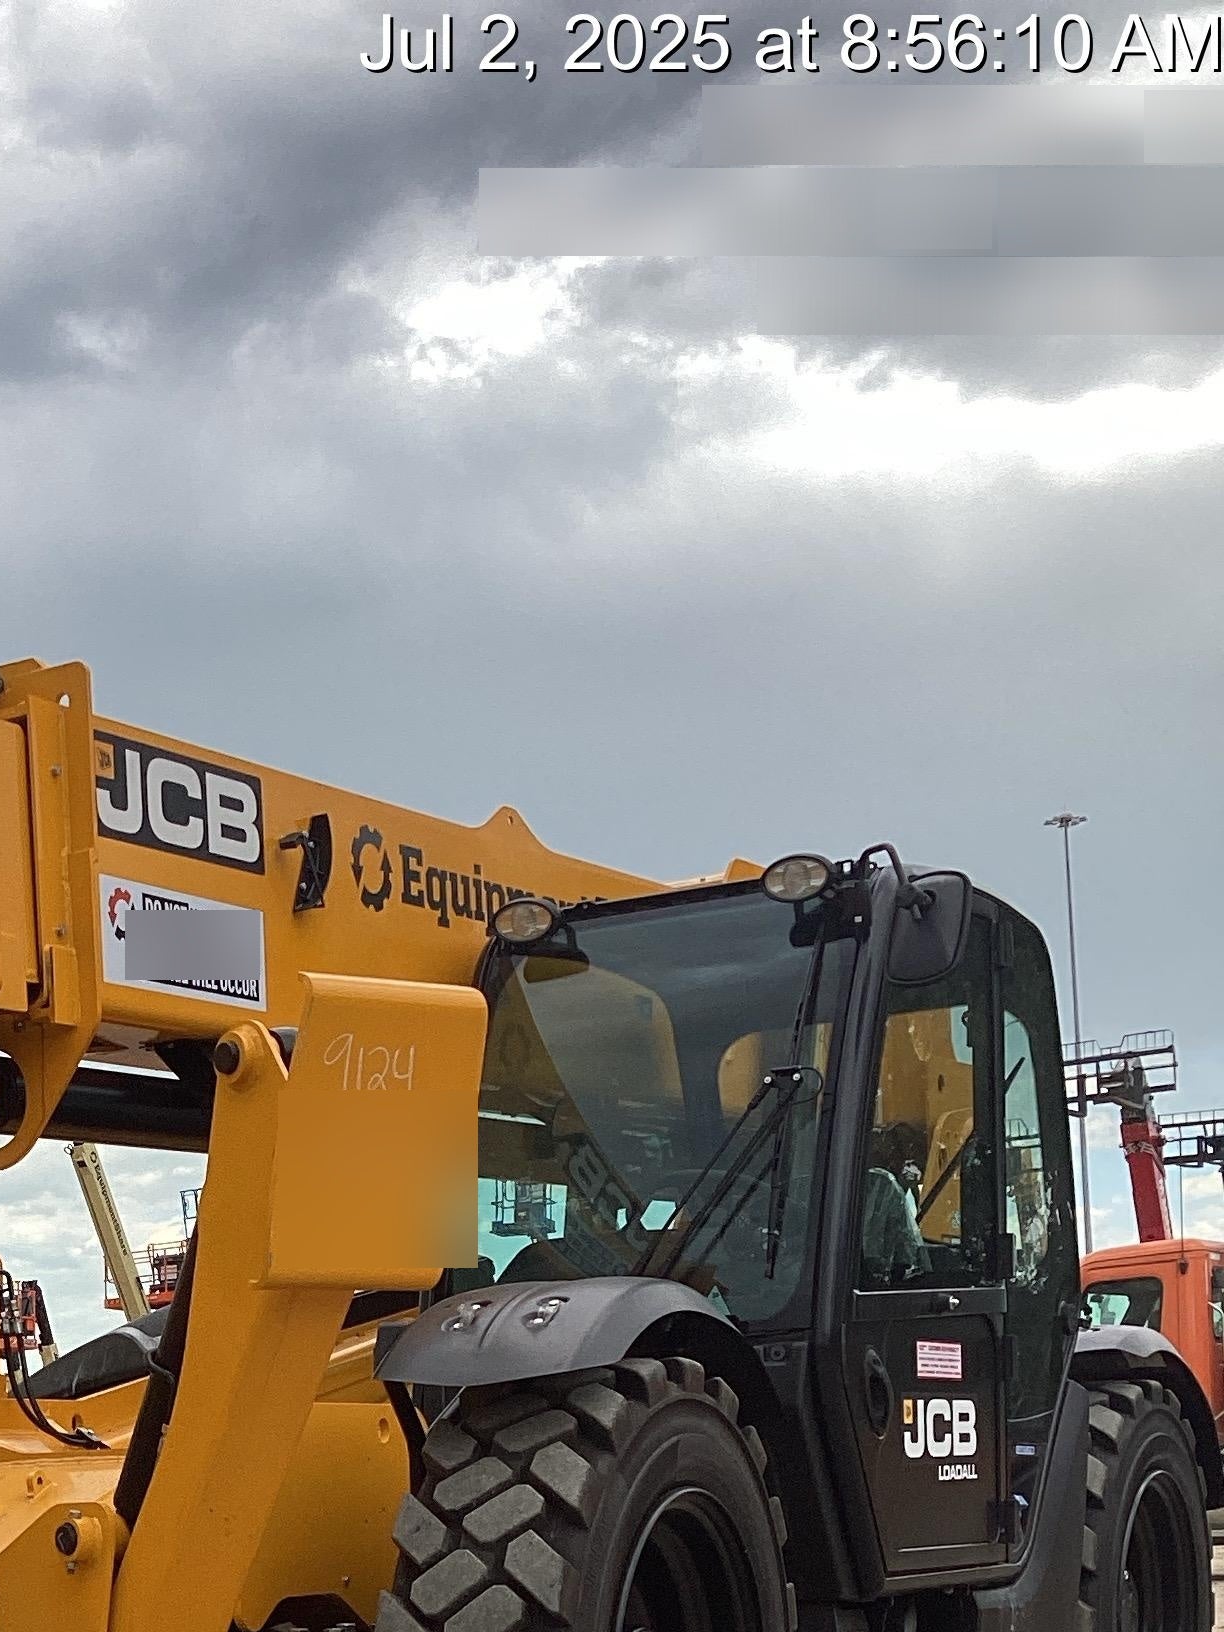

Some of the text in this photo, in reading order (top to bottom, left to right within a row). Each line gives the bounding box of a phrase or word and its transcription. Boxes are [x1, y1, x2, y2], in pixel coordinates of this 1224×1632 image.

[95, 748, 260, 864] JCB
[323, 1032, 415, 1091] 9124
[903, 1398, 978, 1459] JCB
[938, 1463, 978, 1481] LOADALL
